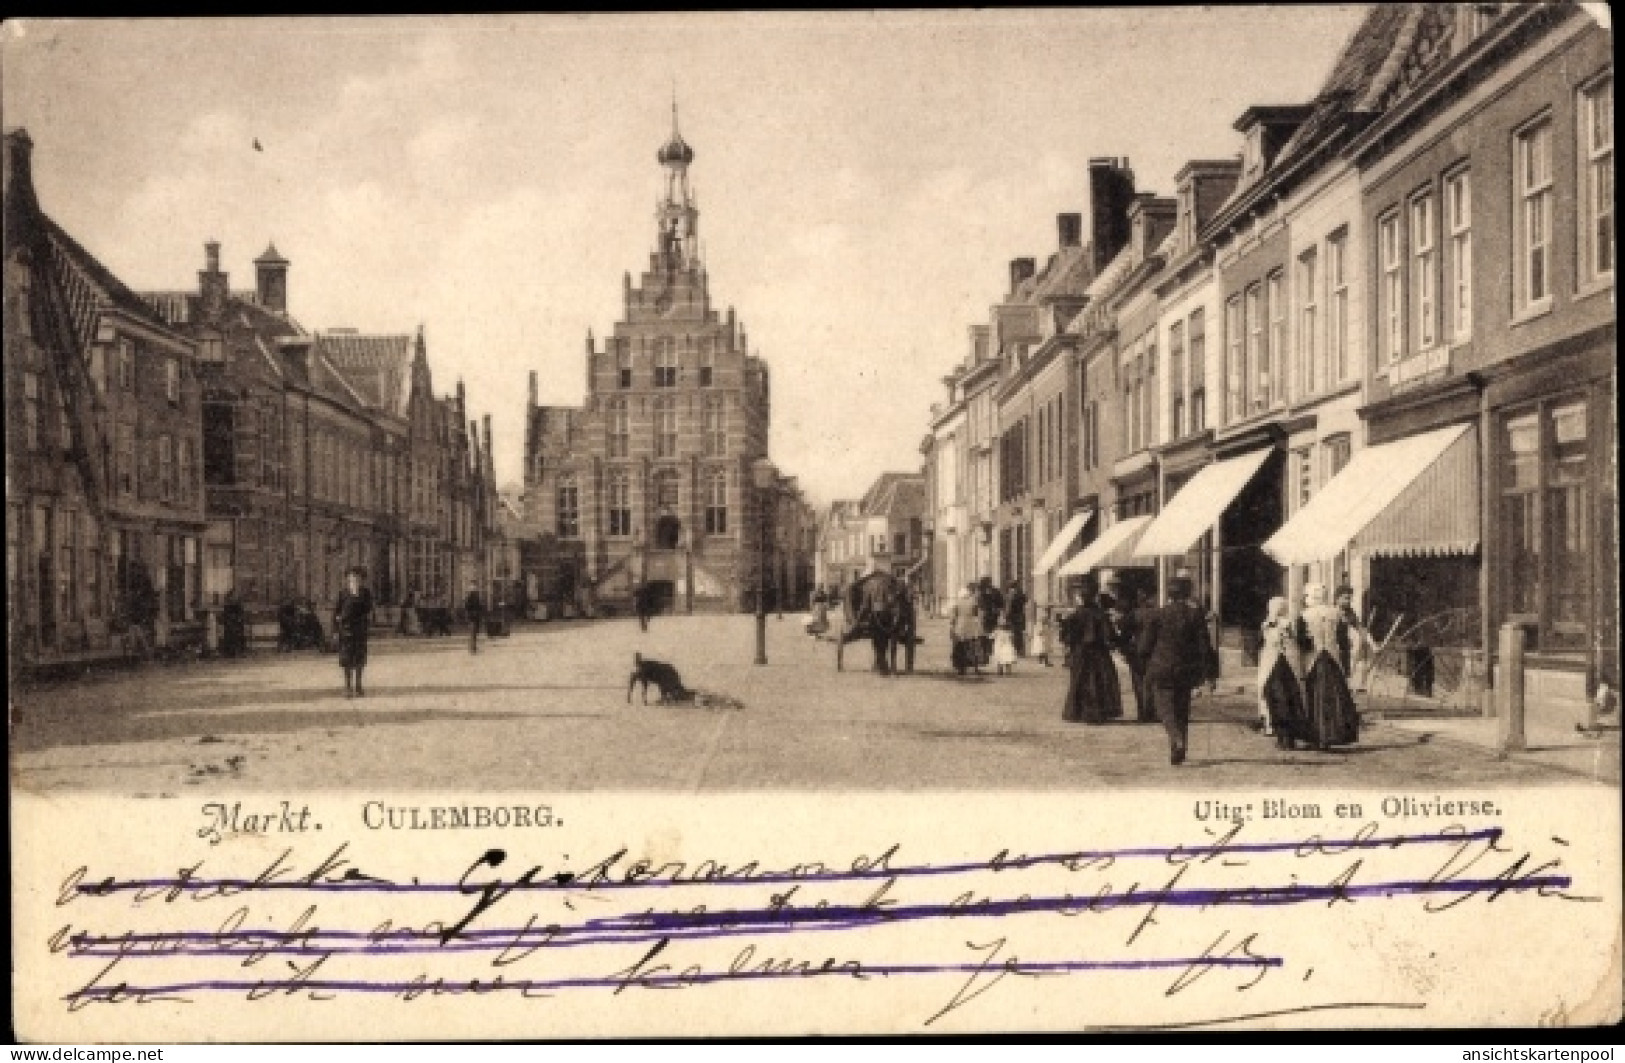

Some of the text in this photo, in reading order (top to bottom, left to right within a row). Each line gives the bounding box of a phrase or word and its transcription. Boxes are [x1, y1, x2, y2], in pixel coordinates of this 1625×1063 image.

[198, 799, 564, 846] Markt. CULEMBORG.
[1262, 797, 1323, 820] Blom
[1335, 799, 1364, 819] en
[1381, 796, 1504, 818] Olivierse.
